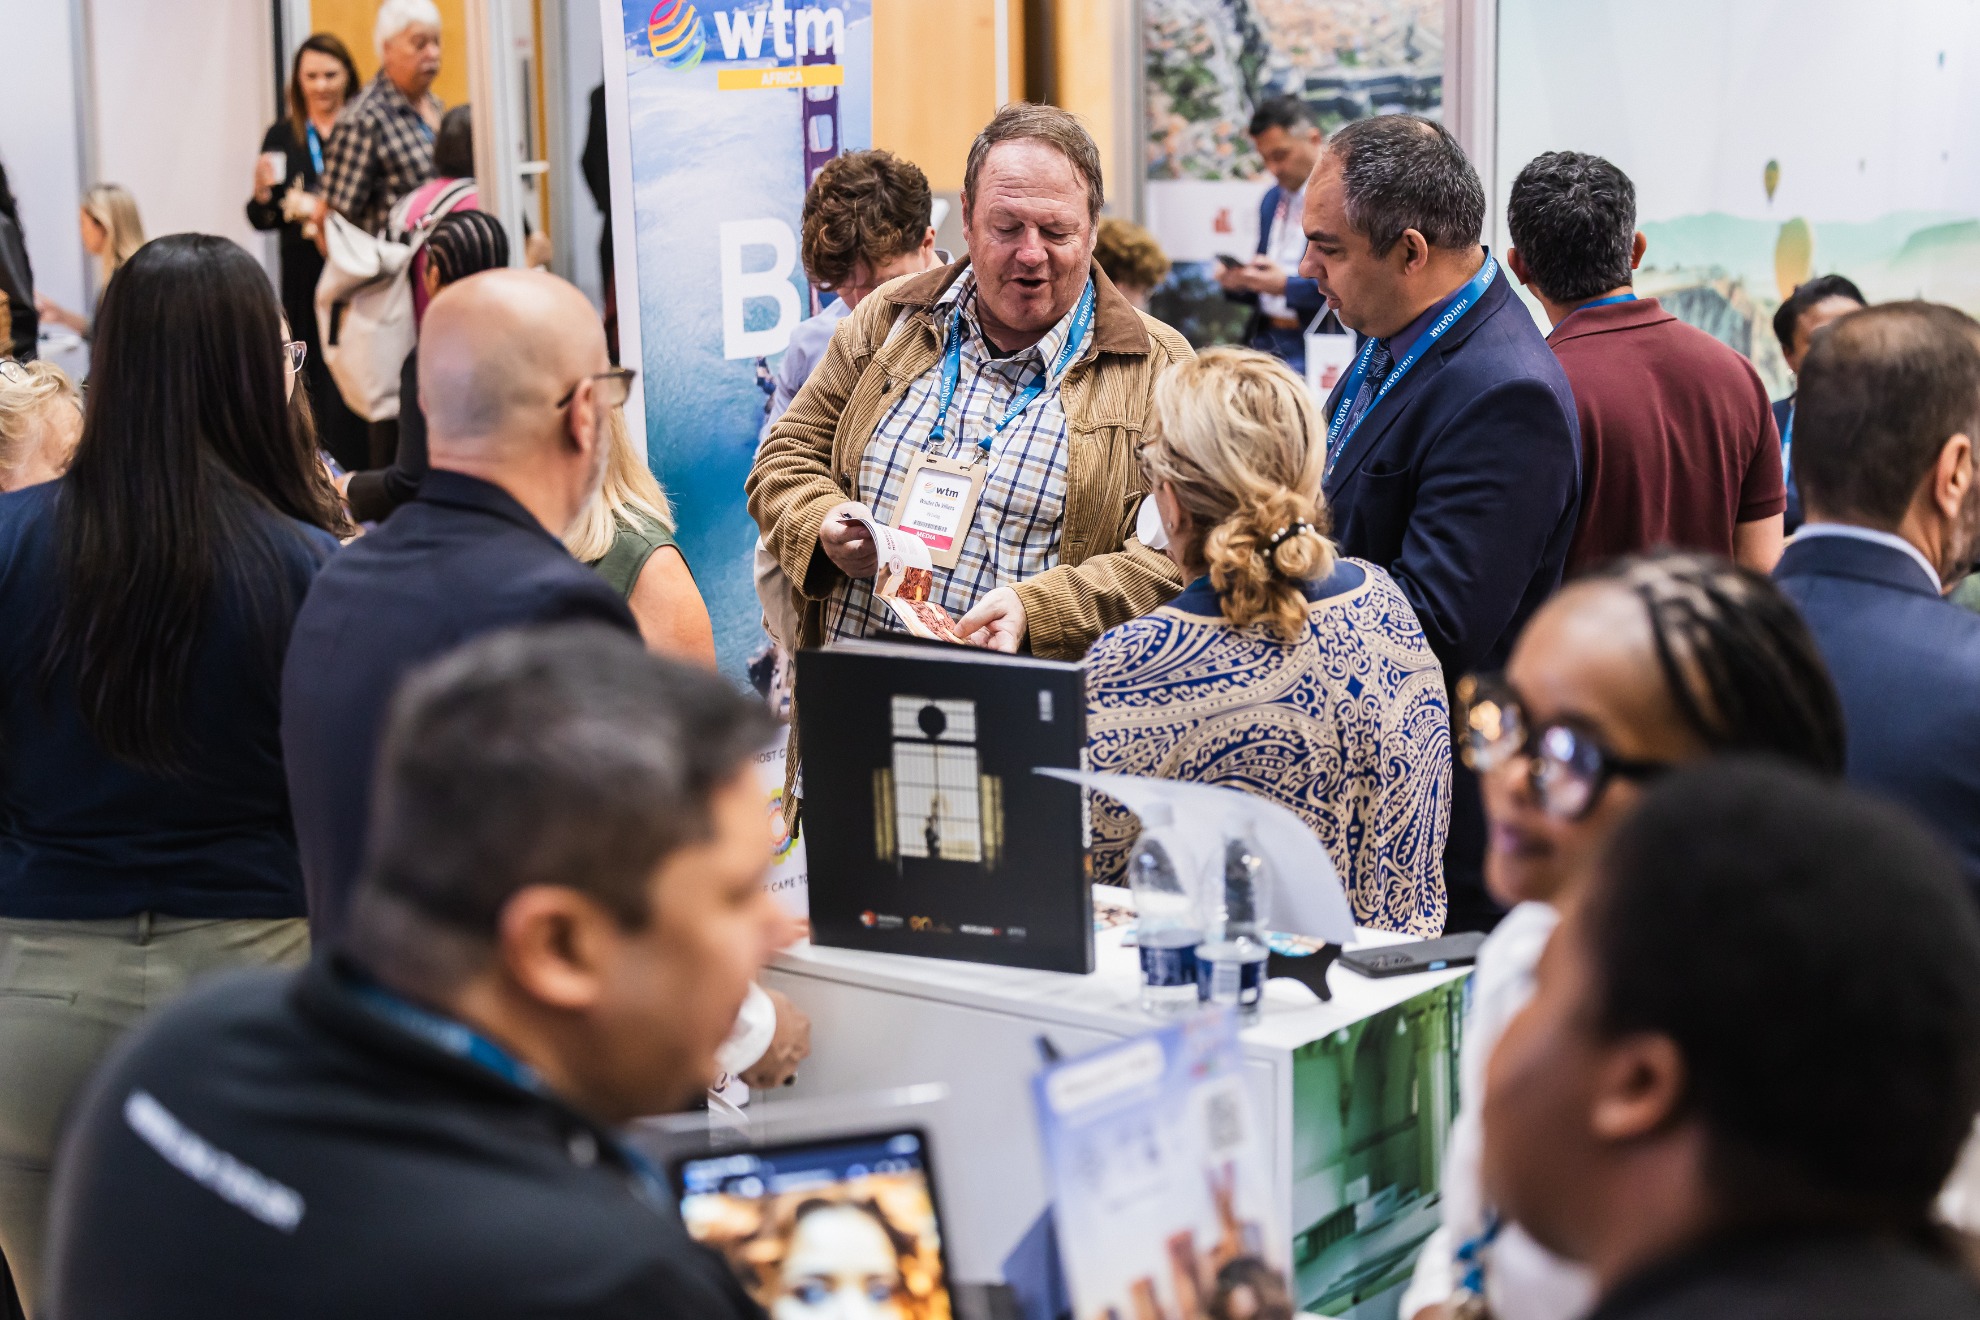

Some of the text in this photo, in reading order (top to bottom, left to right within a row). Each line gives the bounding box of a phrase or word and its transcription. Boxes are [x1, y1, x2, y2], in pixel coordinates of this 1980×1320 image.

[713, 0, 845, 60] wtm
[760, 71, 804, 85] AFRICA
[1429, 298, 1468, 338] visitQATAR
[1357, 336, 1376, 374] visitQAT
[1379, 355, 1414, 396] visitQATAR
[939, 376, 952, 414] visitQATAR
[1327, 398, 1353, 444] visitQATAR
[936, 486, 959, 498] wtm
[916, 531, 936, 541] MEDIA
